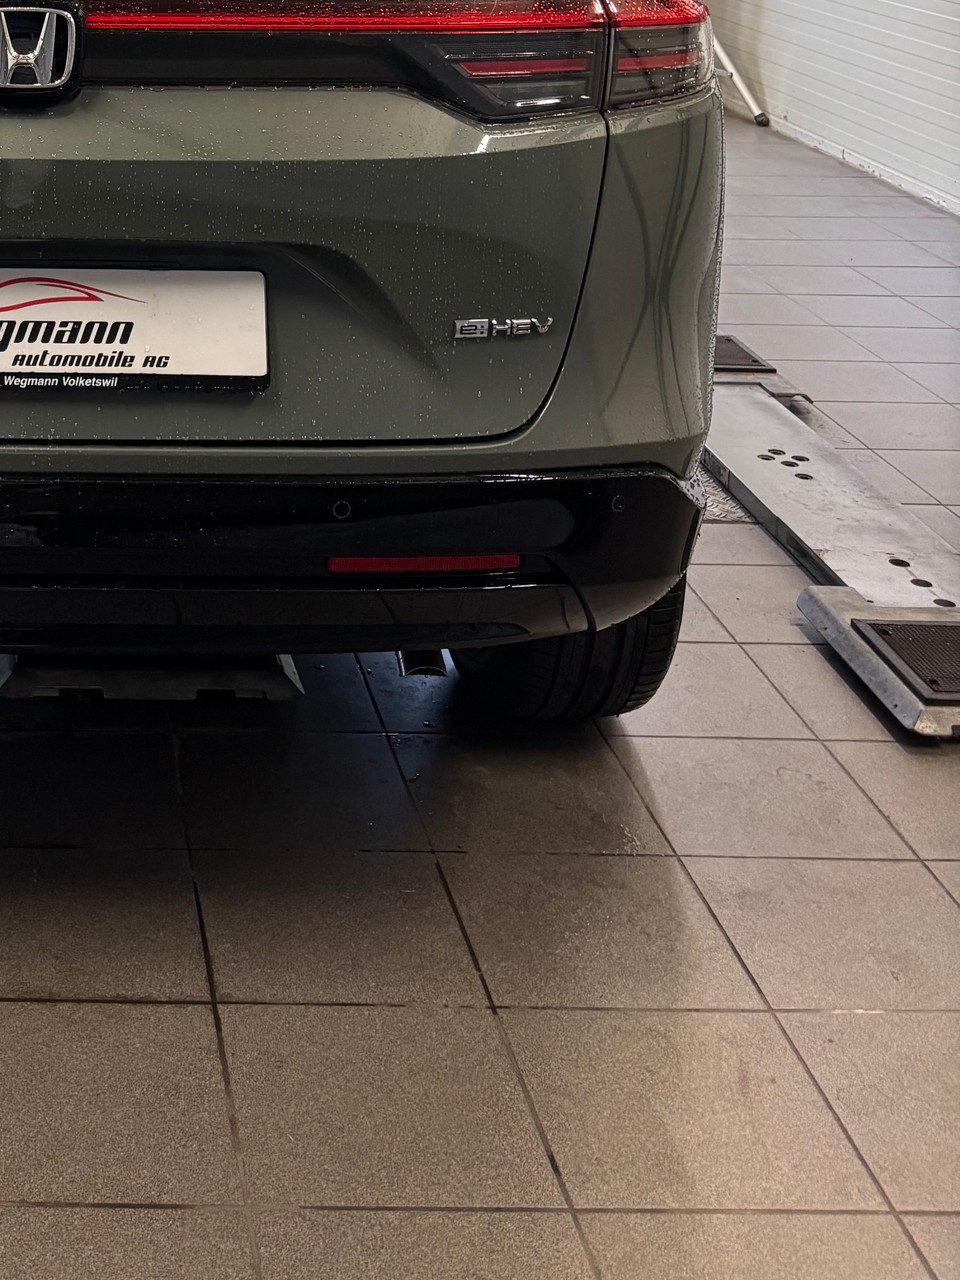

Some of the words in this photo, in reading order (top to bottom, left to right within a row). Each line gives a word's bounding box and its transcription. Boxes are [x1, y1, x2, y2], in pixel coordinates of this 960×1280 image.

[11, 350, 136, 367] automobile
[142, 355, 170, 368] AG
[4, 375, 59, 388] Wegmann
[62, 376, 118, 387] Volketswil
